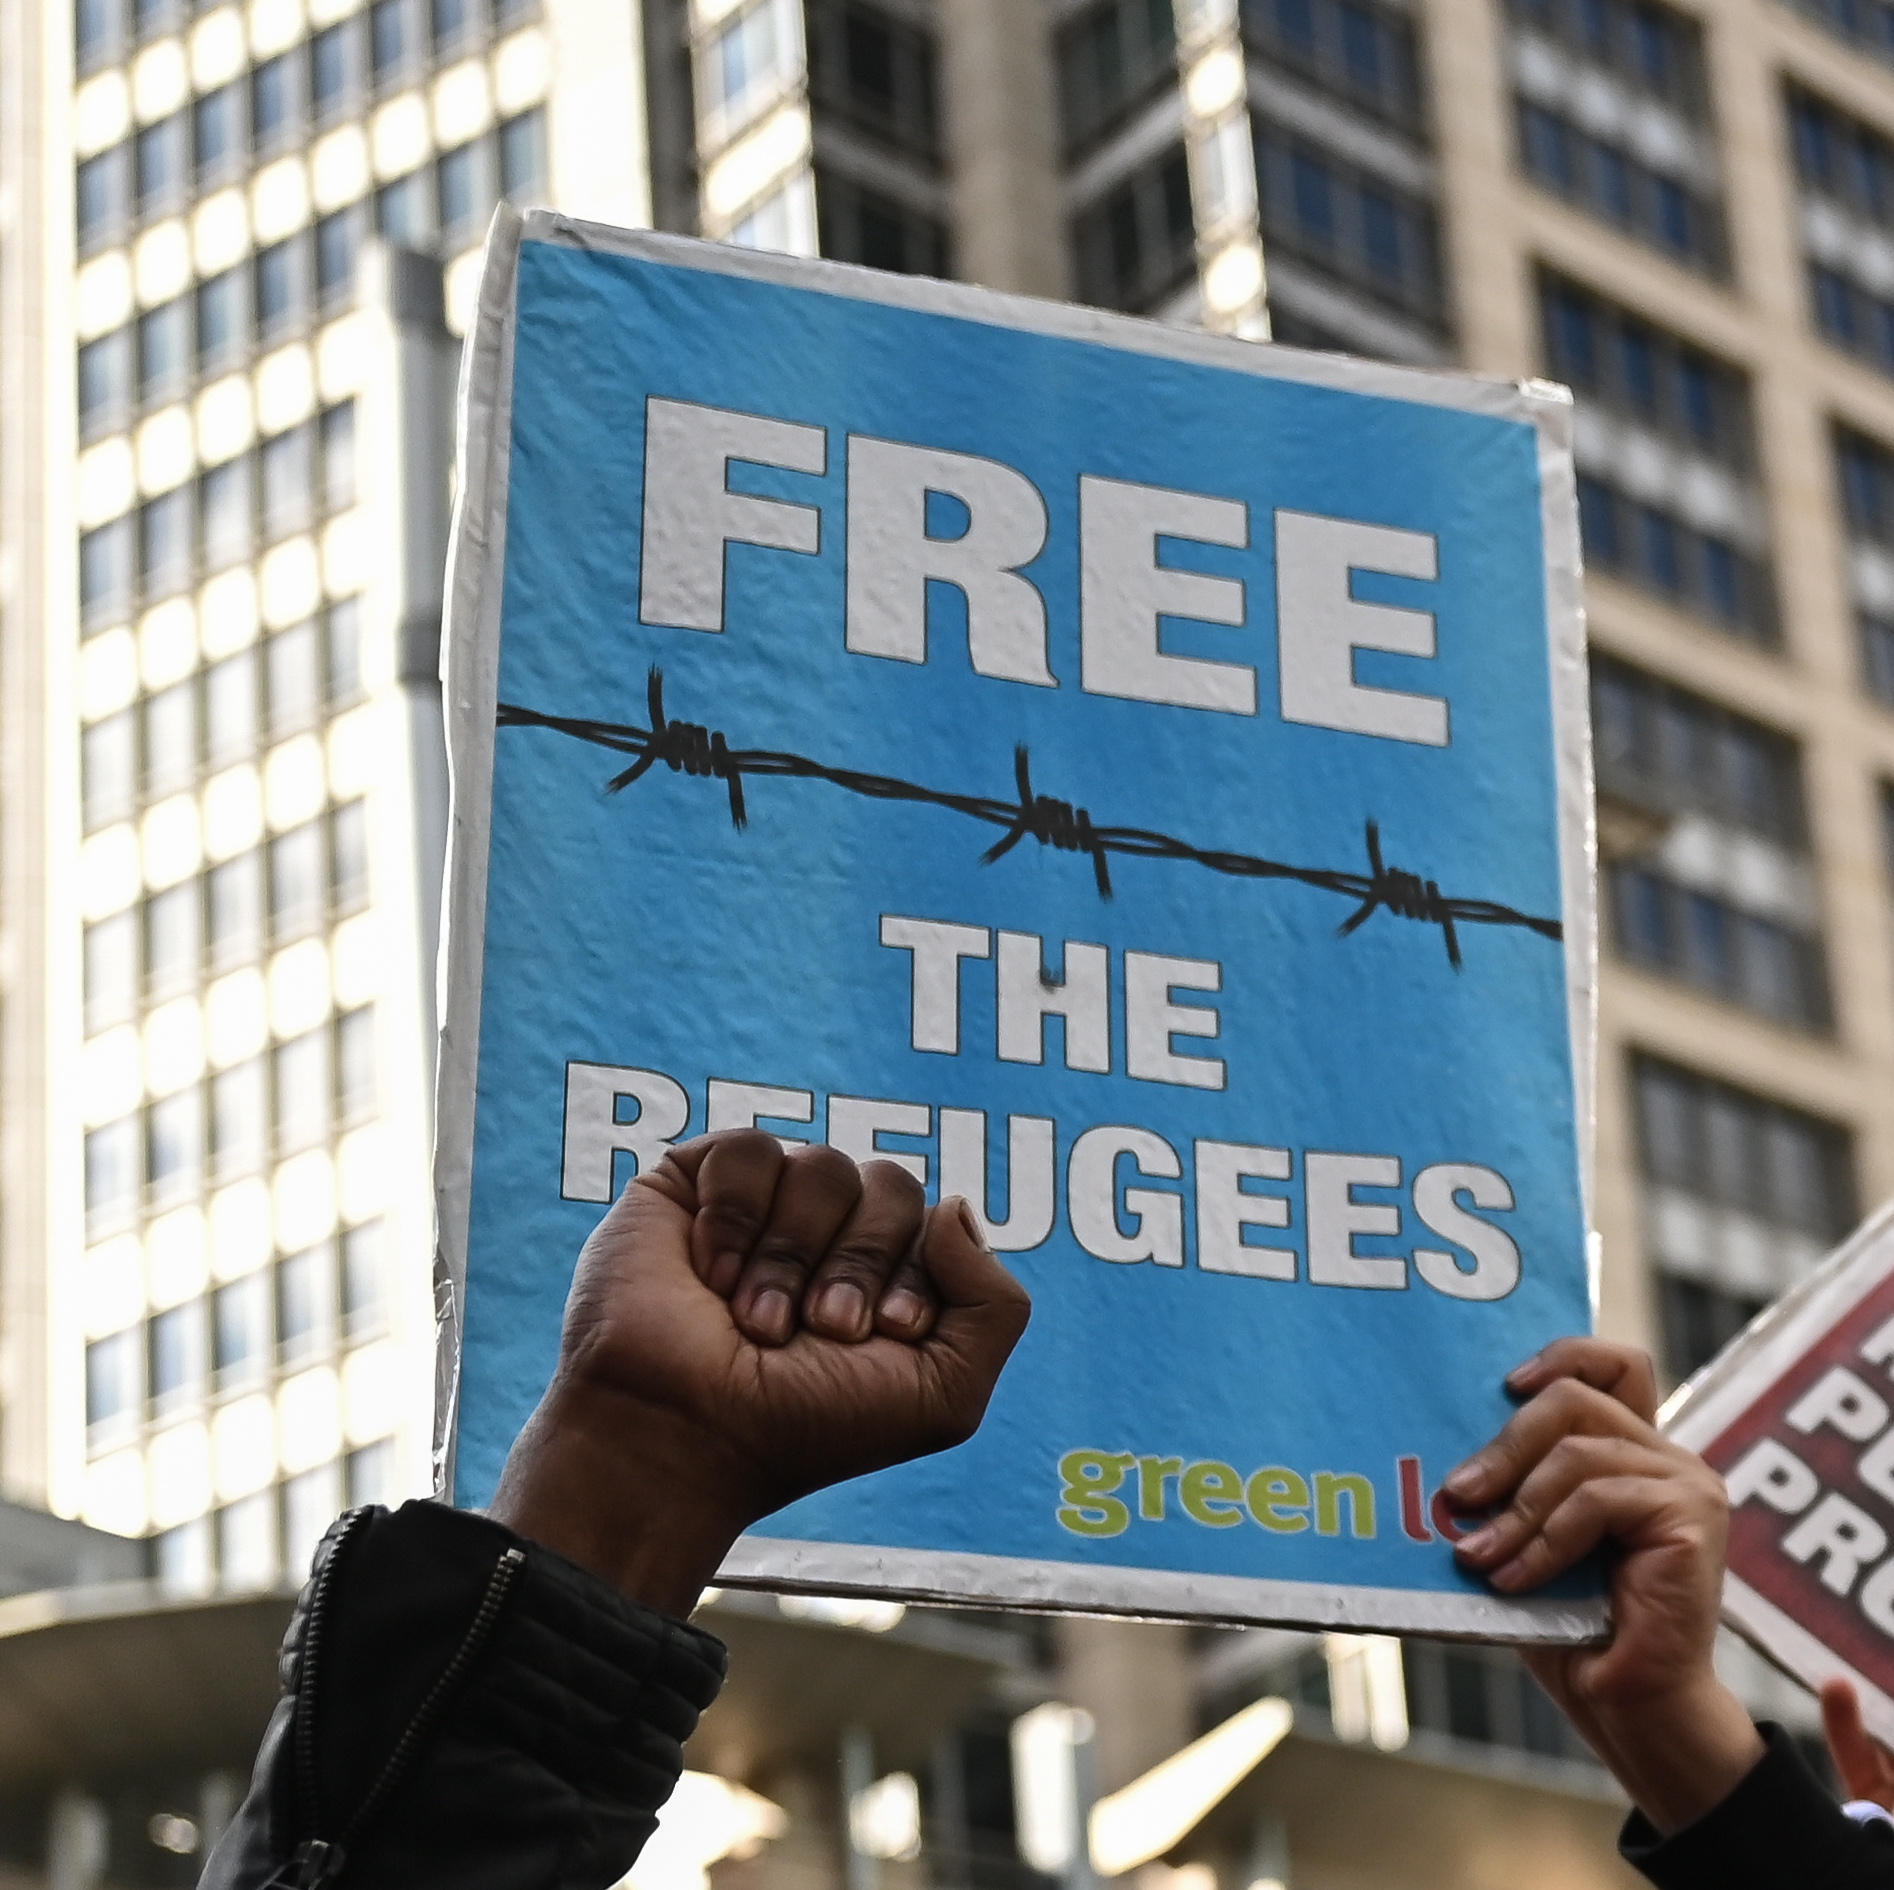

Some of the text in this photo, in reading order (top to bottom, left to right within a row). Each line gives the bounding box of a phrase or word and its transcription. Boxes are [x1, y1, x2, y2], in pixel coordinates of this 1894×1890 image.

[638, 395, 1449, 748] FREE
[879, 912, 1227, 1092] THE
[1055, 1449, 1377, 1539] green
